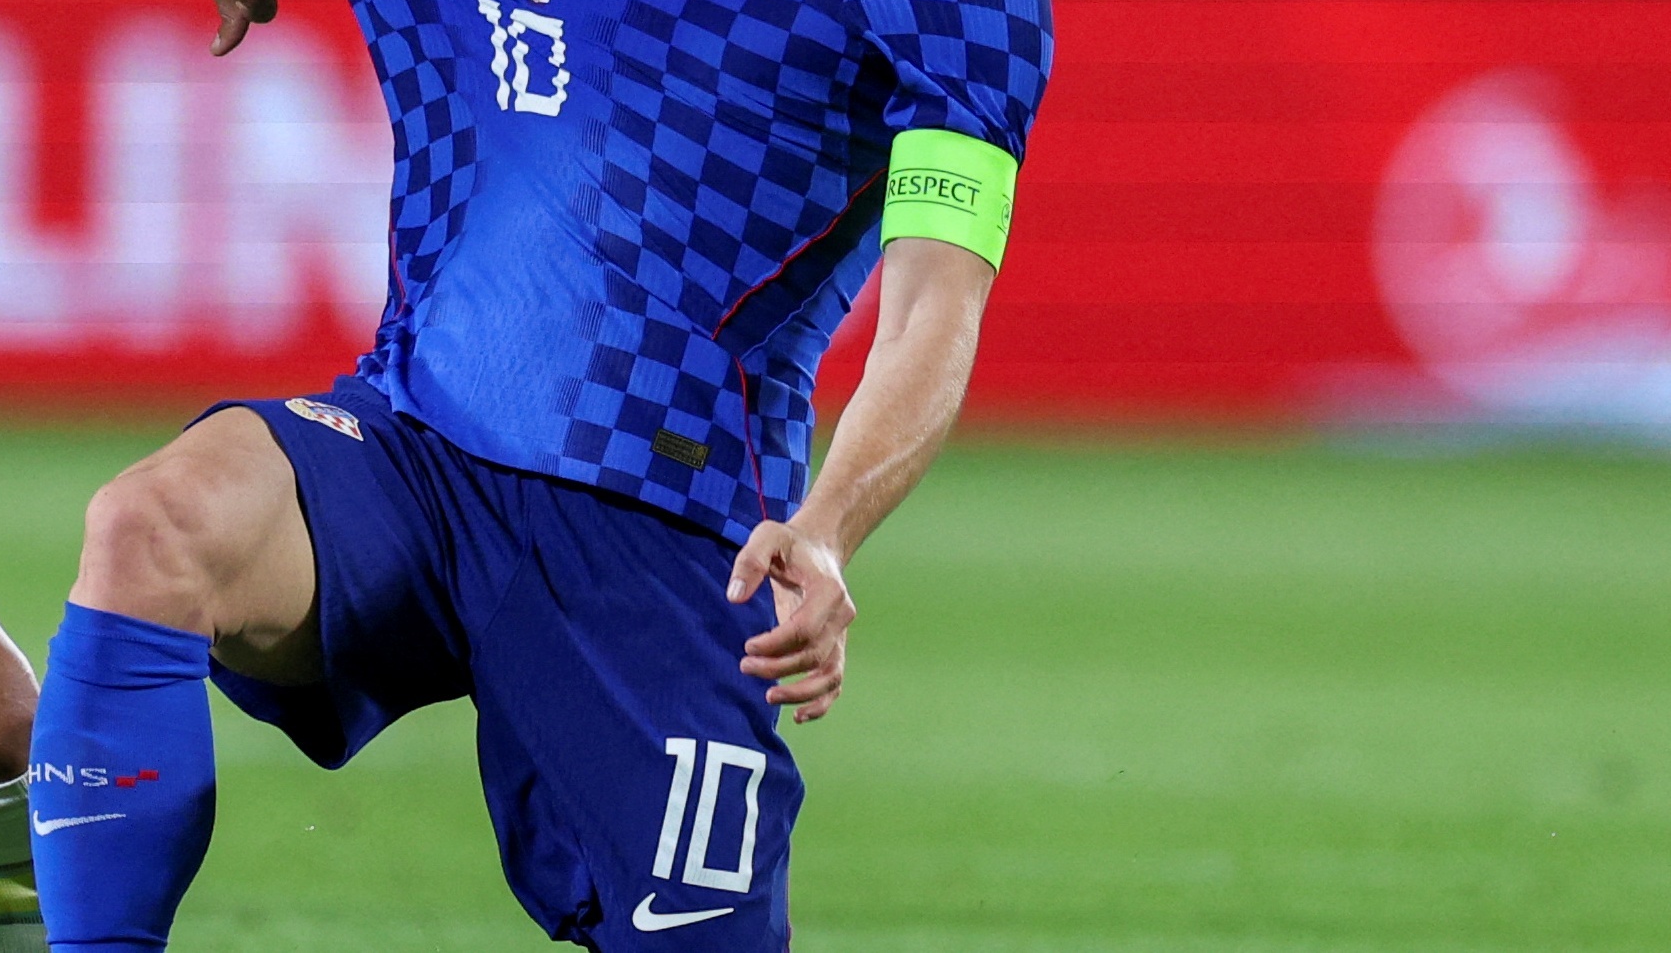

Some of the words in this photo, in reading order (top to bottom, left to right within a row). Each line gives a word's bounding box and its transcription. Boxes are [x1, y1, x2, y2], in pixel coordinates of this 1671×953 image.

[887, 175, 980, 207] RESPECT
[28, 762, 108, 787] HNS
[652, 737, 766, 894] 10
